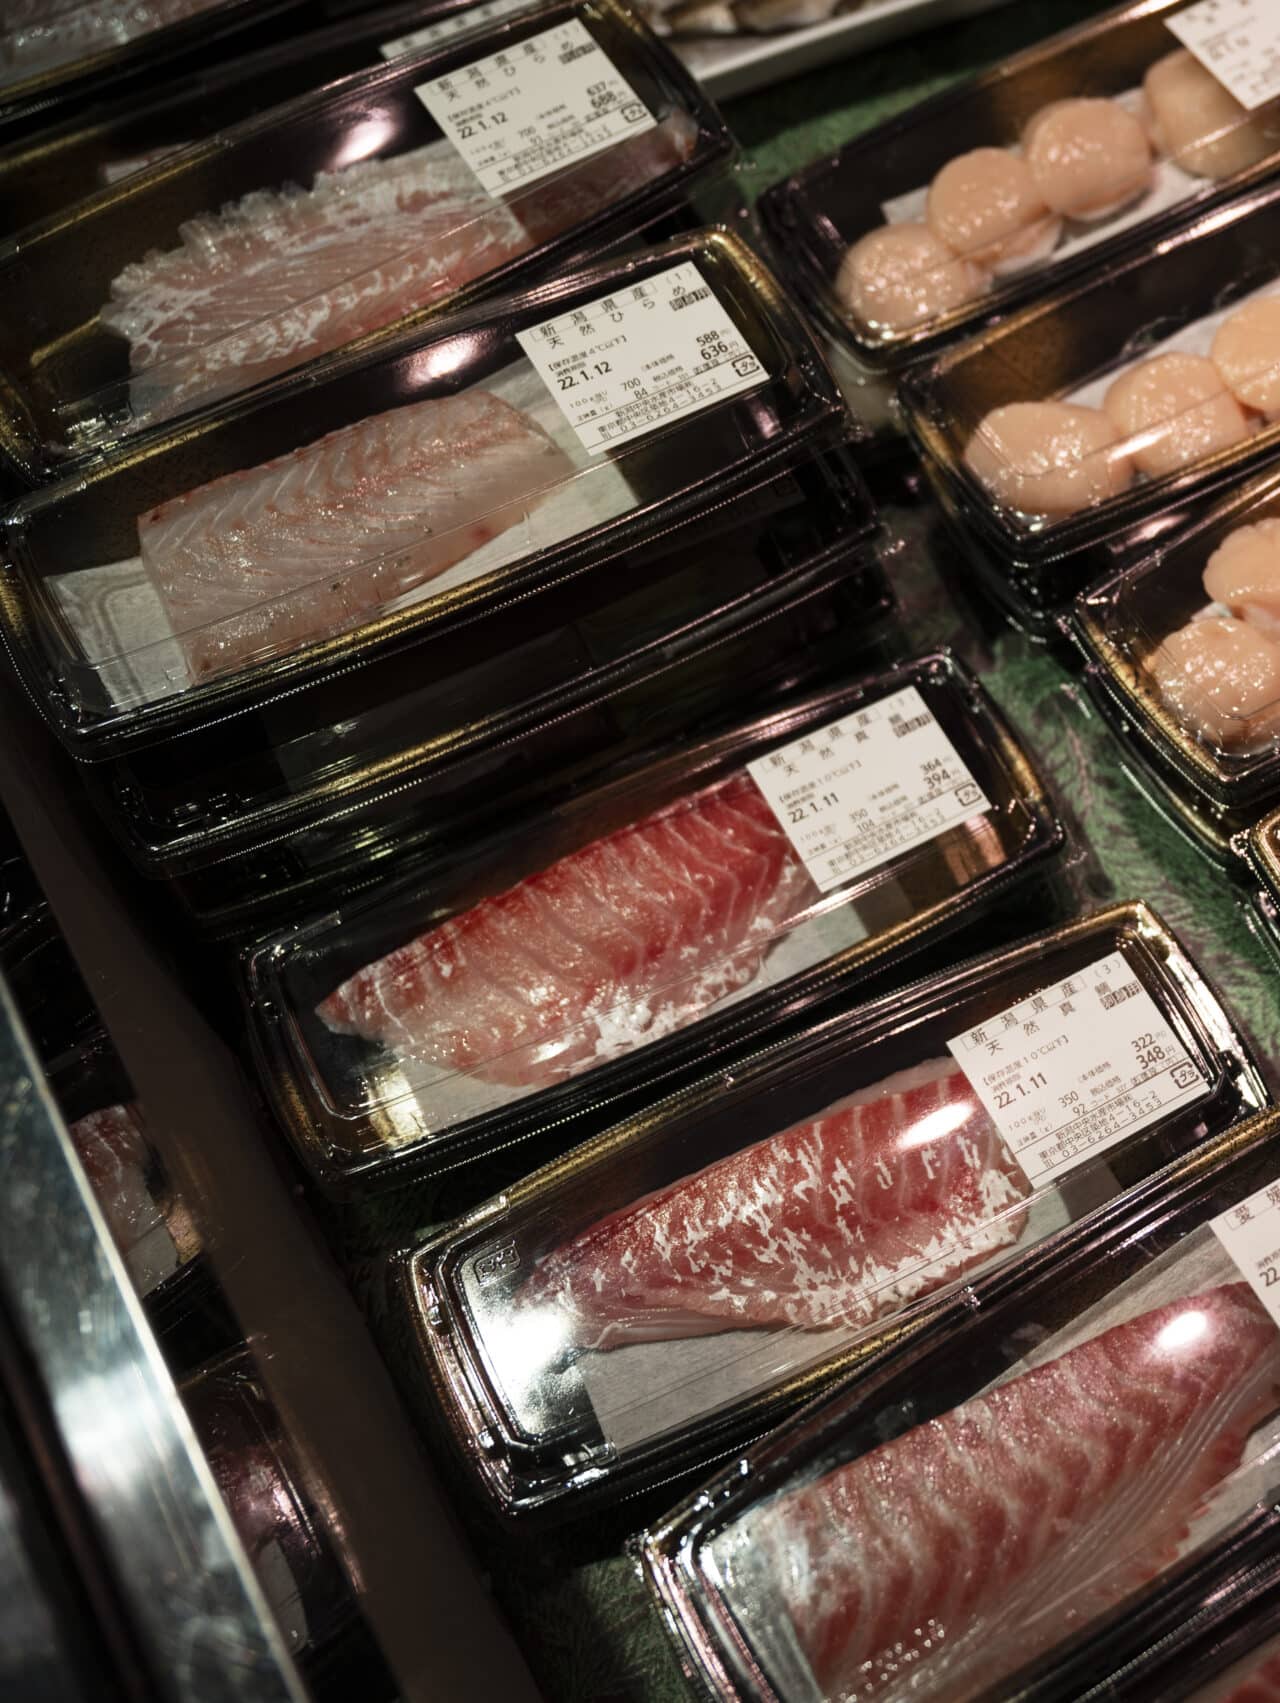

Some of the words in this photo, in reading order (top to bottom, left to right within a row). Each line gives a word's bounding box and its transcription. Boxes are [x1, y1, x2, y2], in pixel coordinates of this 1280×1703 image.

[540, 286, 647, 338] 新潟県産
[547, 286, 686, 349] 天然ひらめ
[621, 378, 640, 391] 700
[634, 388, 648, 399] 84
[857, 819, 875, 832] 104
[970, 981, 1078, 1045] 新潟県産
[985, 982, 1111, 1056] 天然真鯛
[1058, 1091, 1079, 1107] 350
[1073, 1104, 1088, 1117] 92
